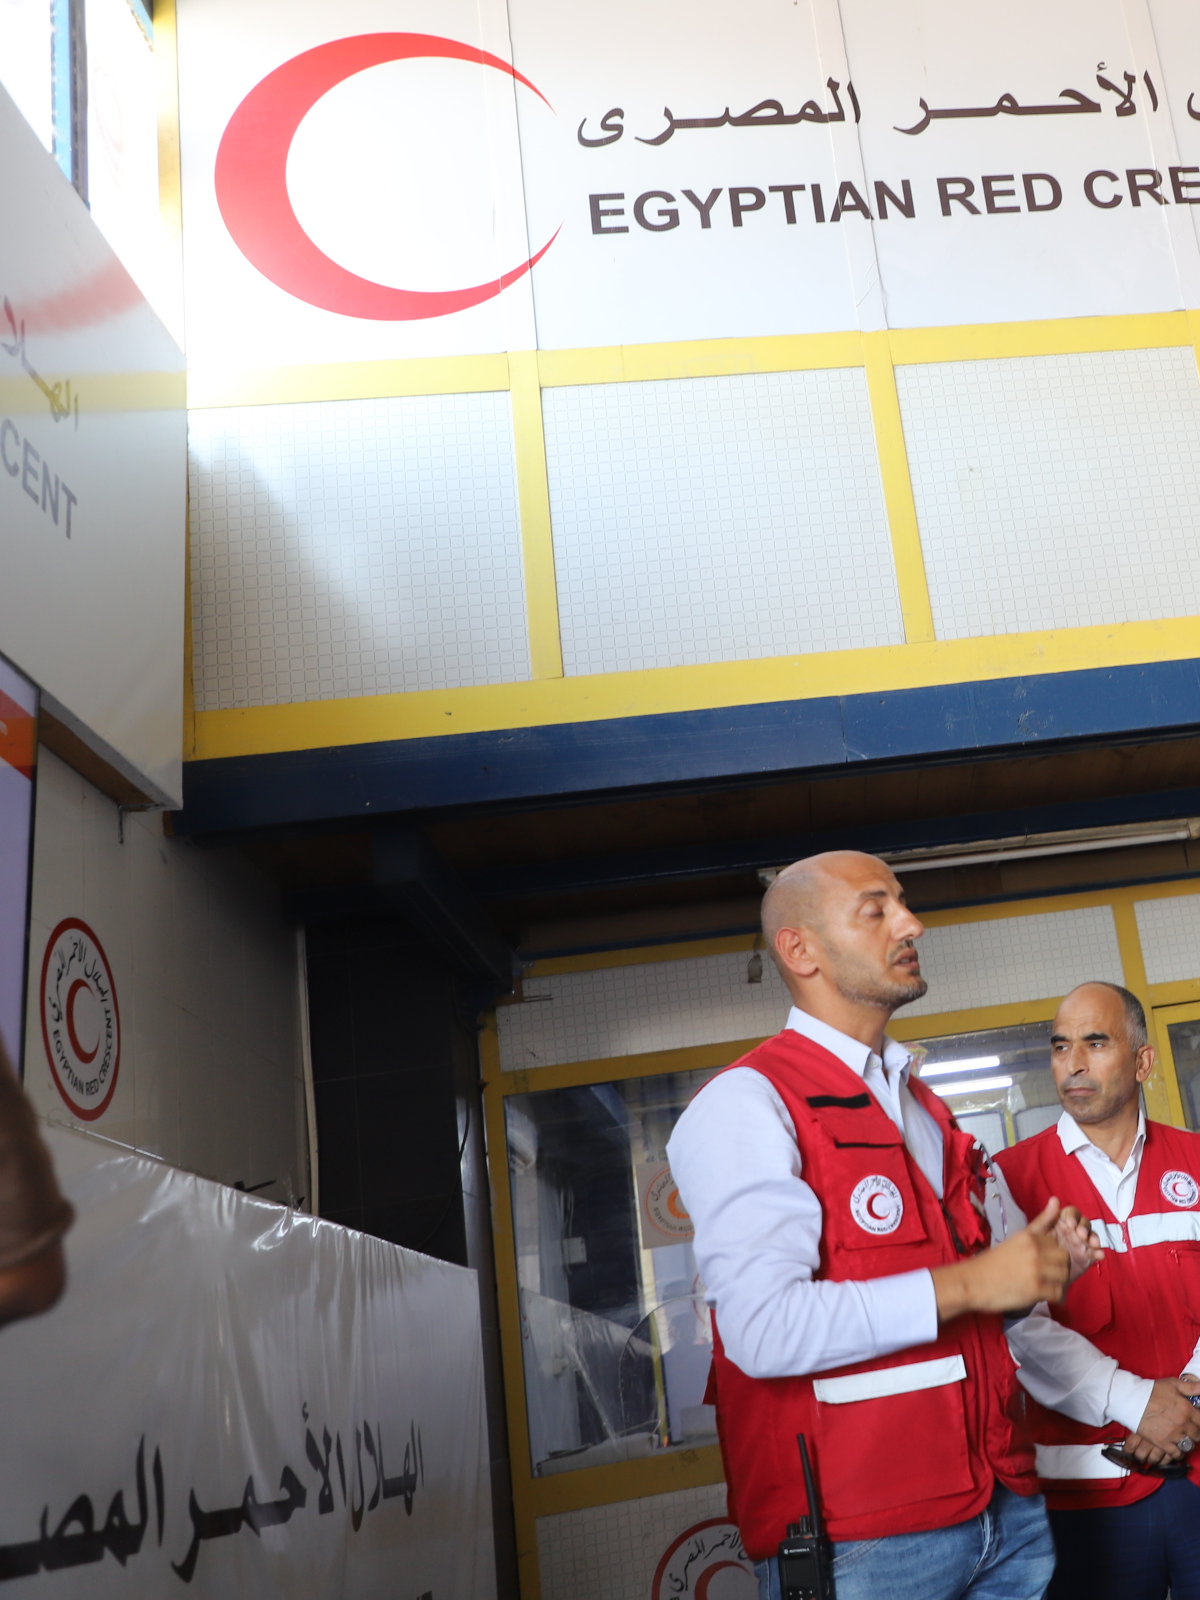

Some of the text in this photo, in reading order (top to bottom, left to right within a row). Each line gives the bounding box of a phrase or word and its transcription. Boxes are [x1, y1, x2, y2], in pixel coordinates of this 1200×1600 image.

[893, 62, 1159, 136] الأحمر
[588, 178, 916, 235] EGYPTIAN
[936, 173, 1064, 217] RED
[53, 1006, 113, 1097] EGYPTIAN RED CRESCENT
[0, 1401, 425, 1583] الهلال الأحمر المص
